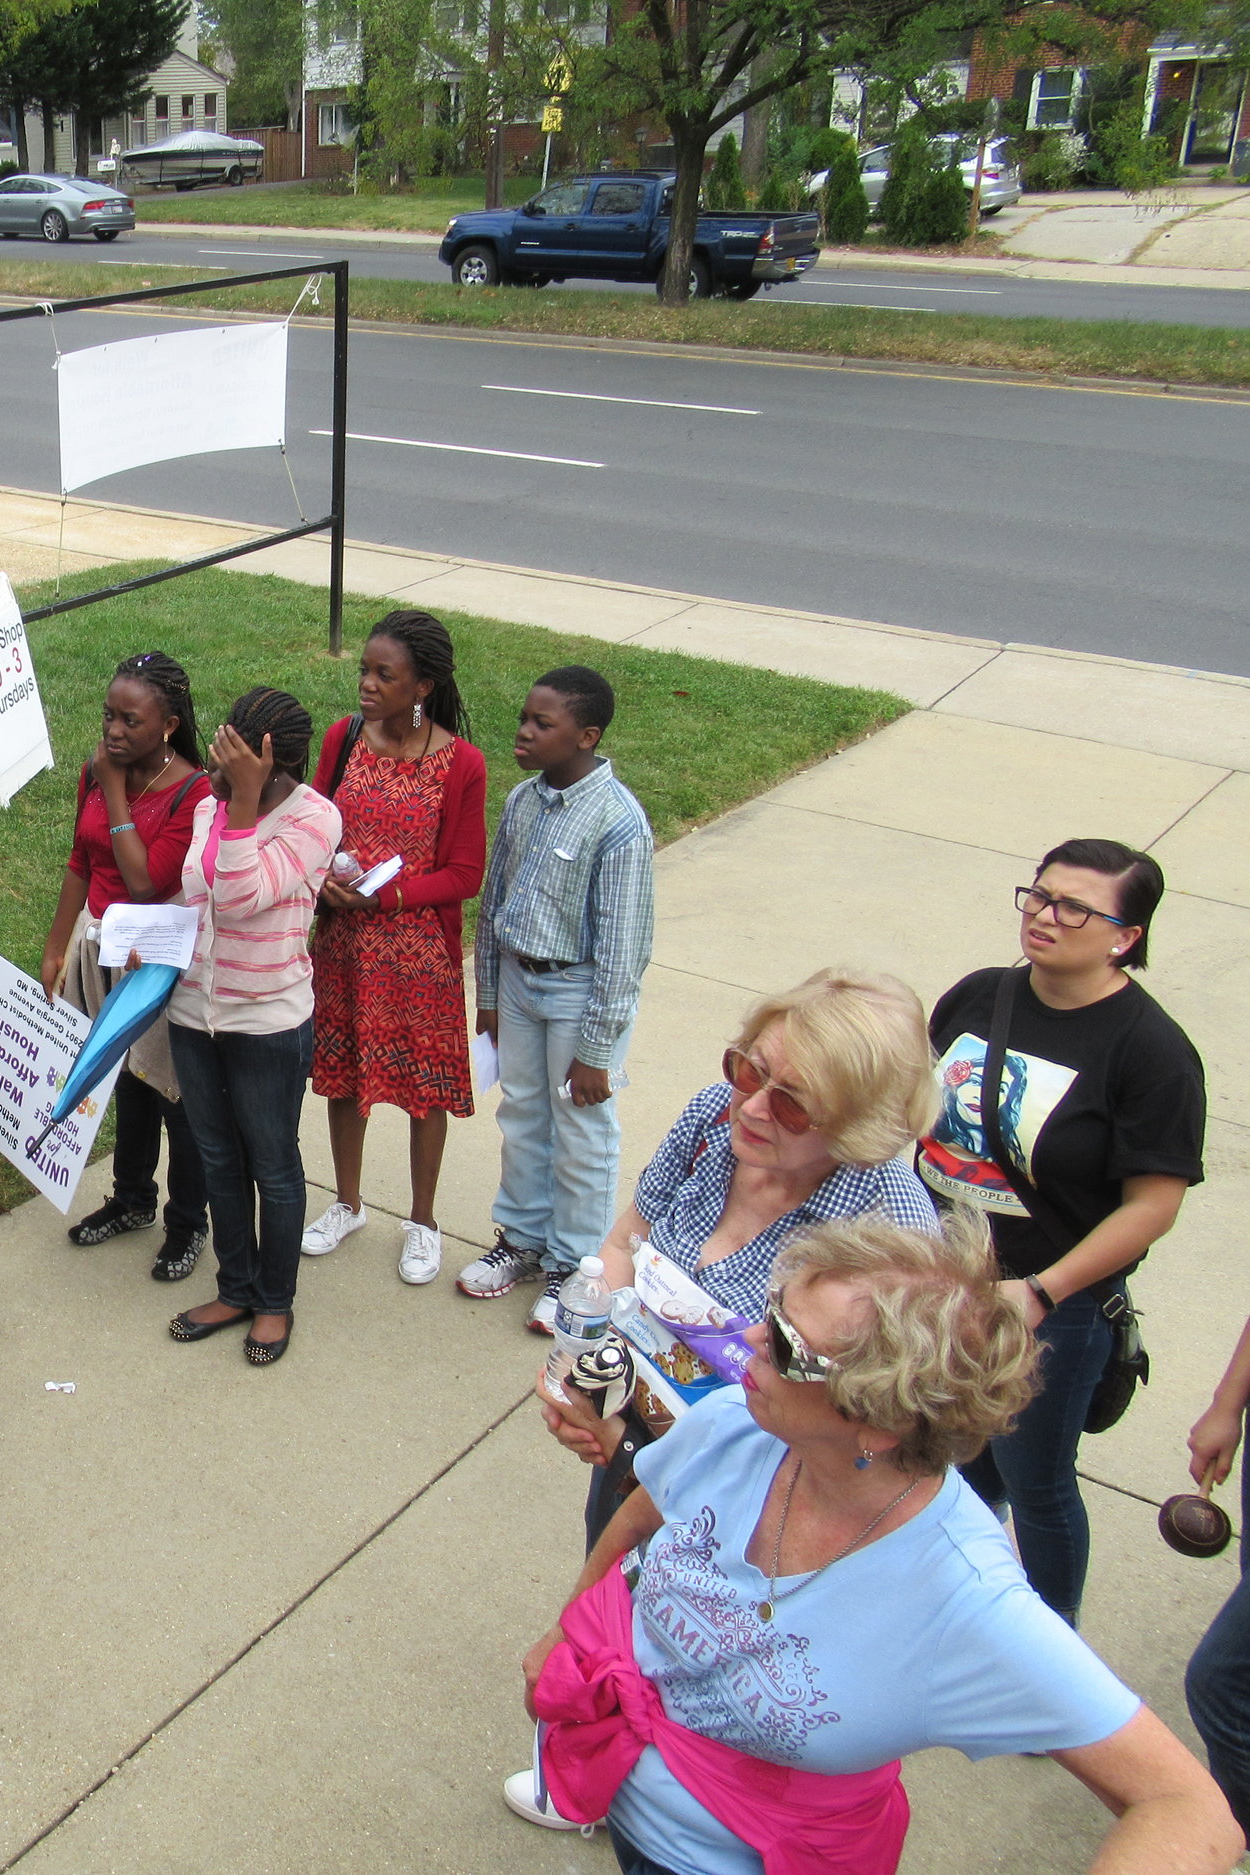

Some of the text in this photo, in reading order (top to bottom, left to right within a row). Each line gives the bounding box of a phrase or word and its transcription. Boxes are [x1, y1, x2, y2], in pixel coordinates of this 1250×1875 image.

[12, 647, 23, 673] 3
[16, 979, 29, 992] MD
[8, 989, 36, 1012] Avenue
[8, 1005, 45, 1038] Methodist
[36, 1008, 65, 1034] Georgia
[55, 1007, 78, 1027] Silver
[45, 1031, 69, 1054] United
[34, 1107, 82, 1156] AFFORDBLE
[45, 1101, 80, 1138] HOUG
[24, 1135, 70, 1187] UNITED
[46, 1139, 62, 1157] for
[925, 1166, 1013, 1203] WE THE PEOPLE
[654, 1274, 678, 1297] Oatmeal
[625, 1321, 649, 1345] Cookies
[631, 1314, 650, 1334] Candy
[683, 1573, 738, 1600] UNITED
[748, 1600, 789, 1650] STES
[654, 1603, 764, 1719] AMERICA
